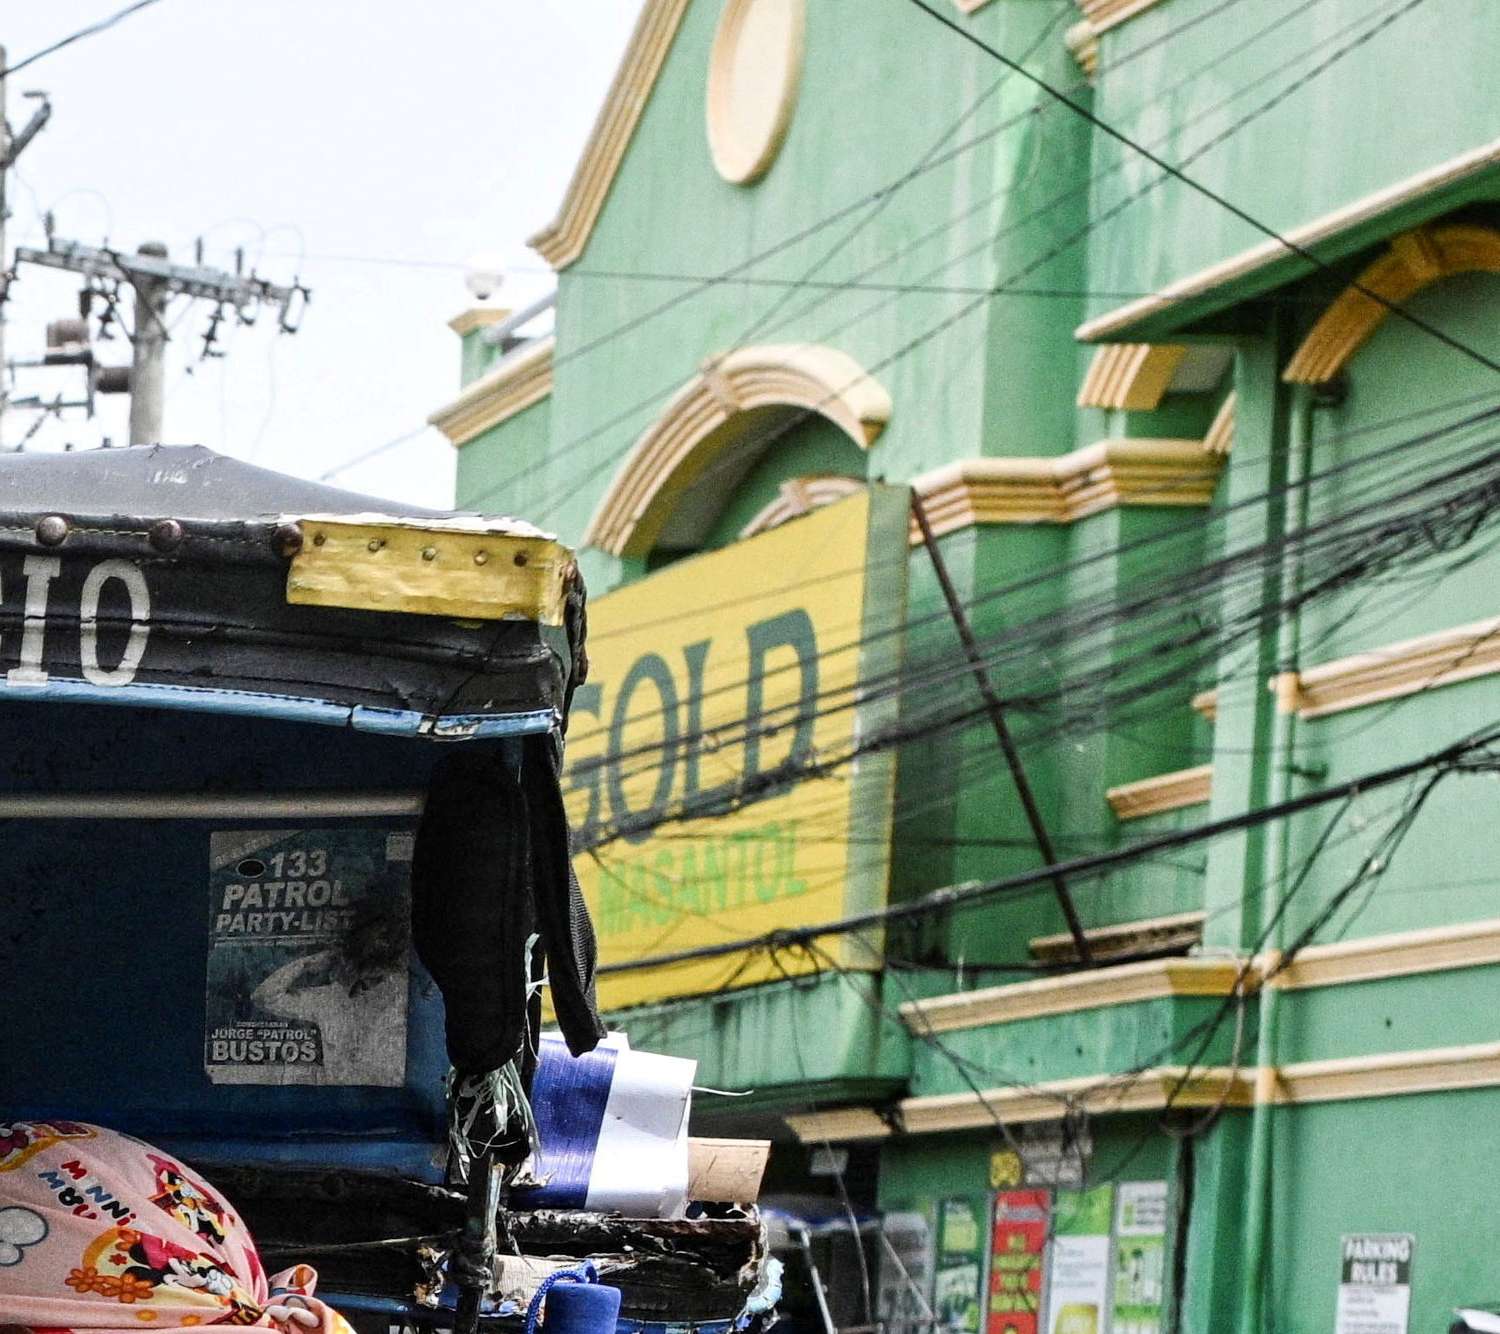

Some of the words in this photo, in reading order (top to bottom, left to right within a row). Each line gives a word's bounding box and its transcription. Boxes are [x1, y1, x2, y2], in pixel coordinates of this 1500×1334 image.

[565, 608, 820, 862] GOLD
[269, 849, 328, 878] 133
[222, 879, 349, 910] PATROL
[215, 909, 356, 934] PARTY-LIST
[211, 1028, 254, 1040] JORGE
[211, 1040, 317, 1063] BUSTOS
[1344, 1238, 1412, 1263] PARKING
[1350, 1261, 1399, 1284] RULES
